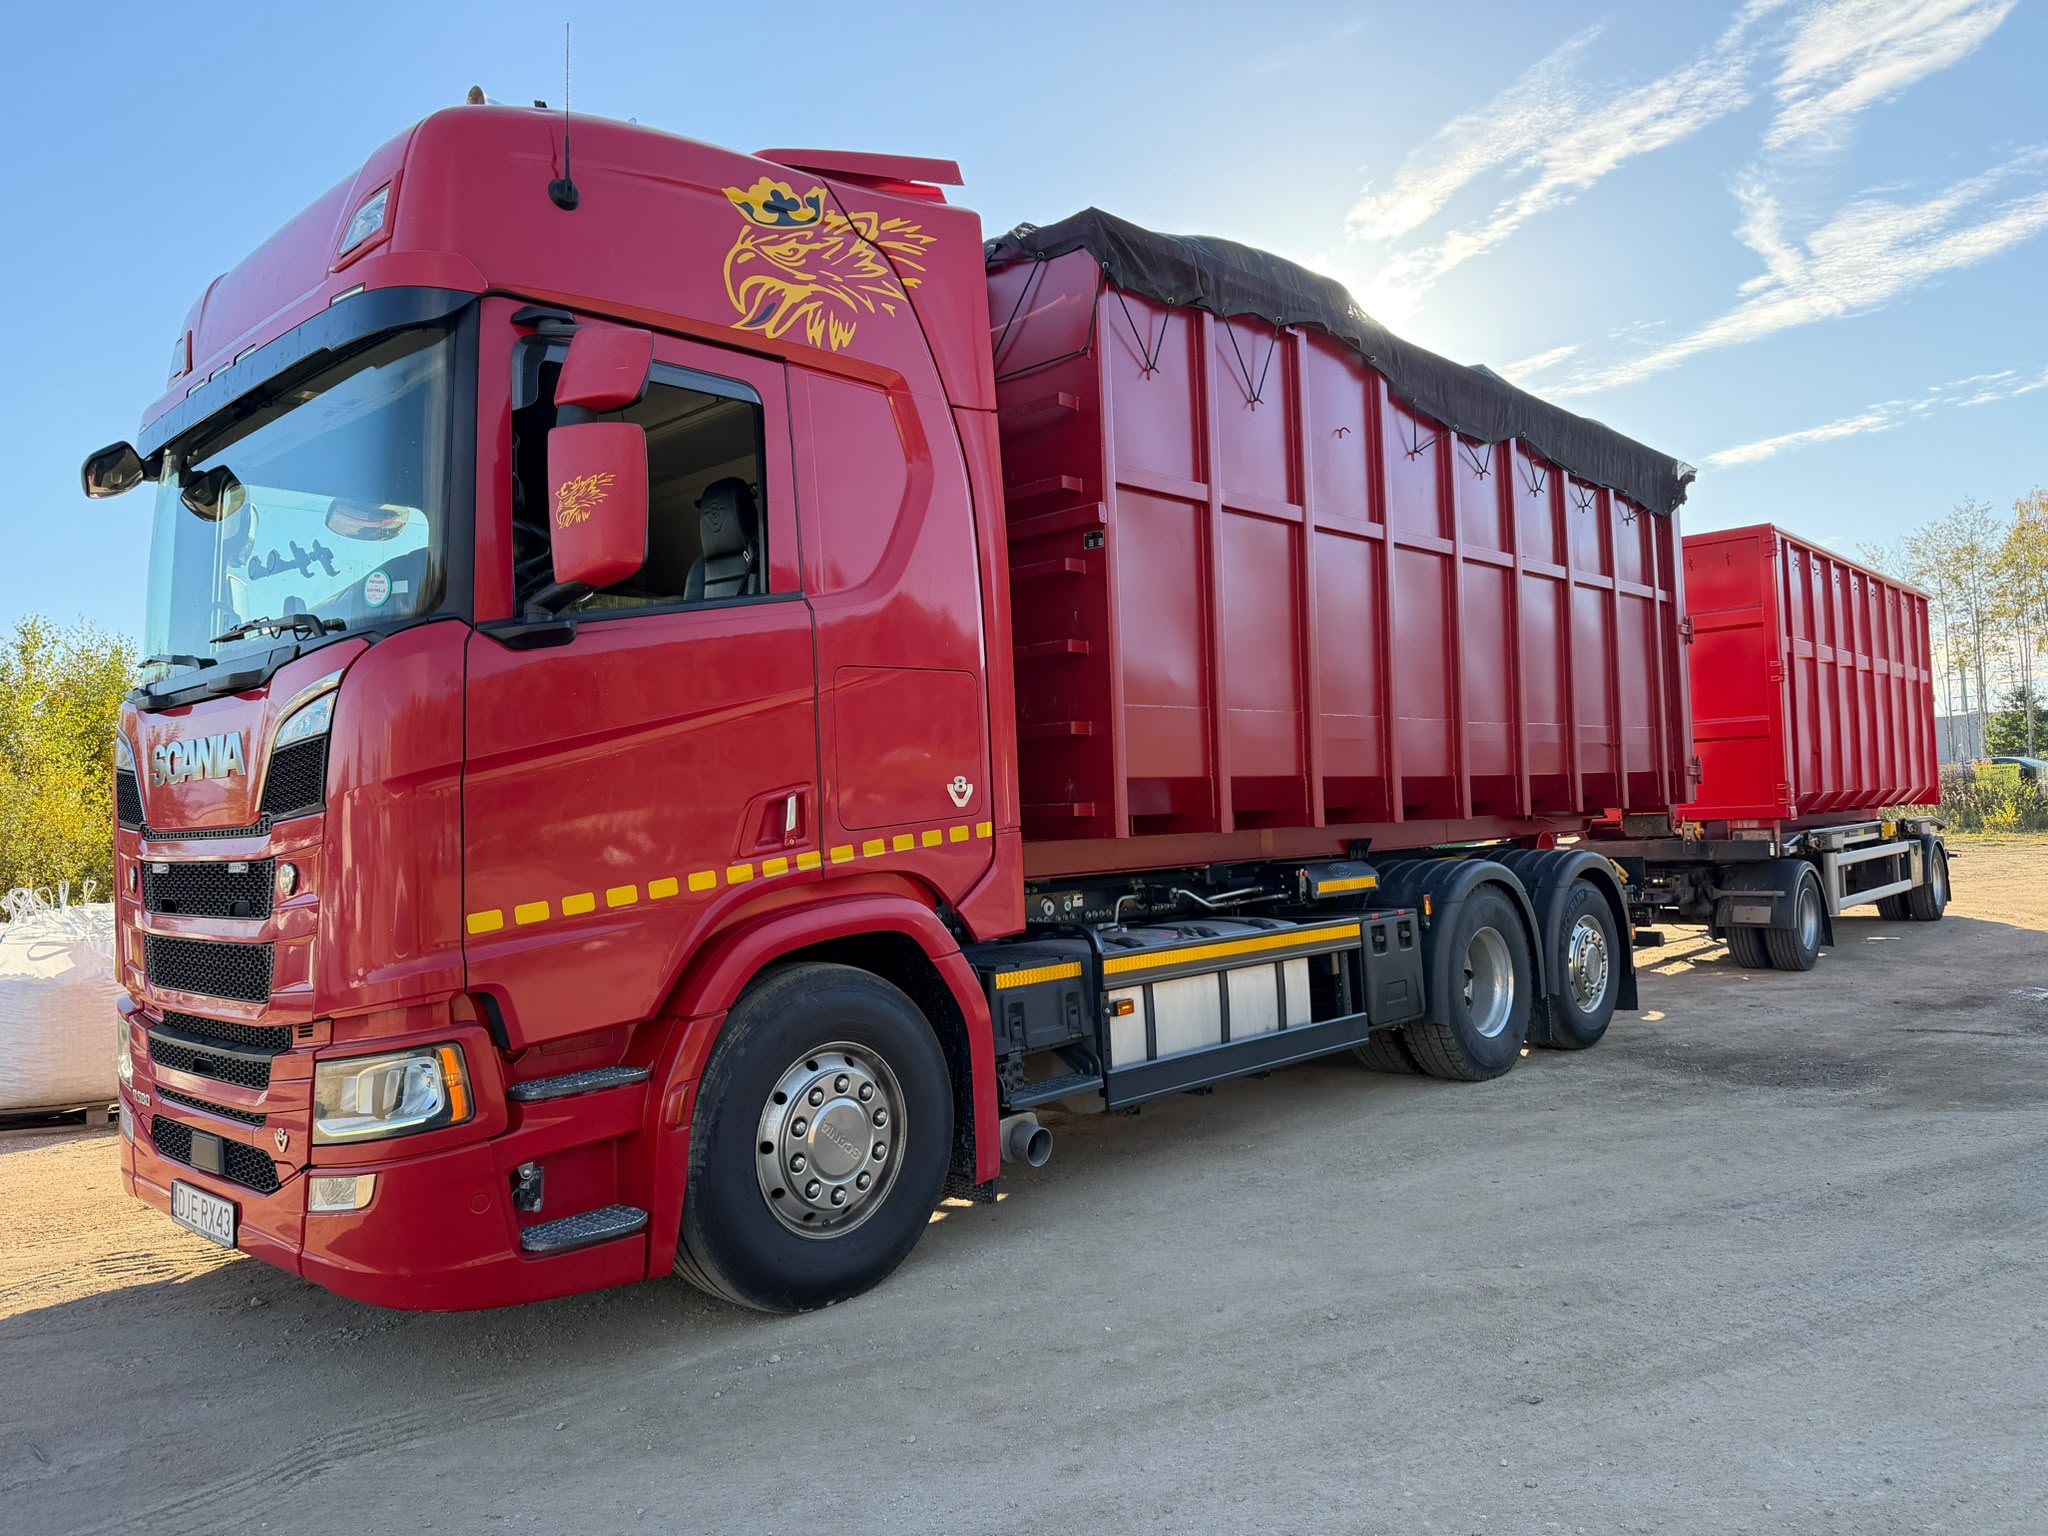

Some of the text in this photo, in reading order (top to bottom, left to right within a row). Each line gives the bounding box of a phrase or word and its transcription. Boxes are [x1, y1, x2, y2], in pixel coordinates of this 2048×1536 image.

[150, 731, 247, 788] SCANIA
[177, 1188, 231, 1238] DJE RX43
